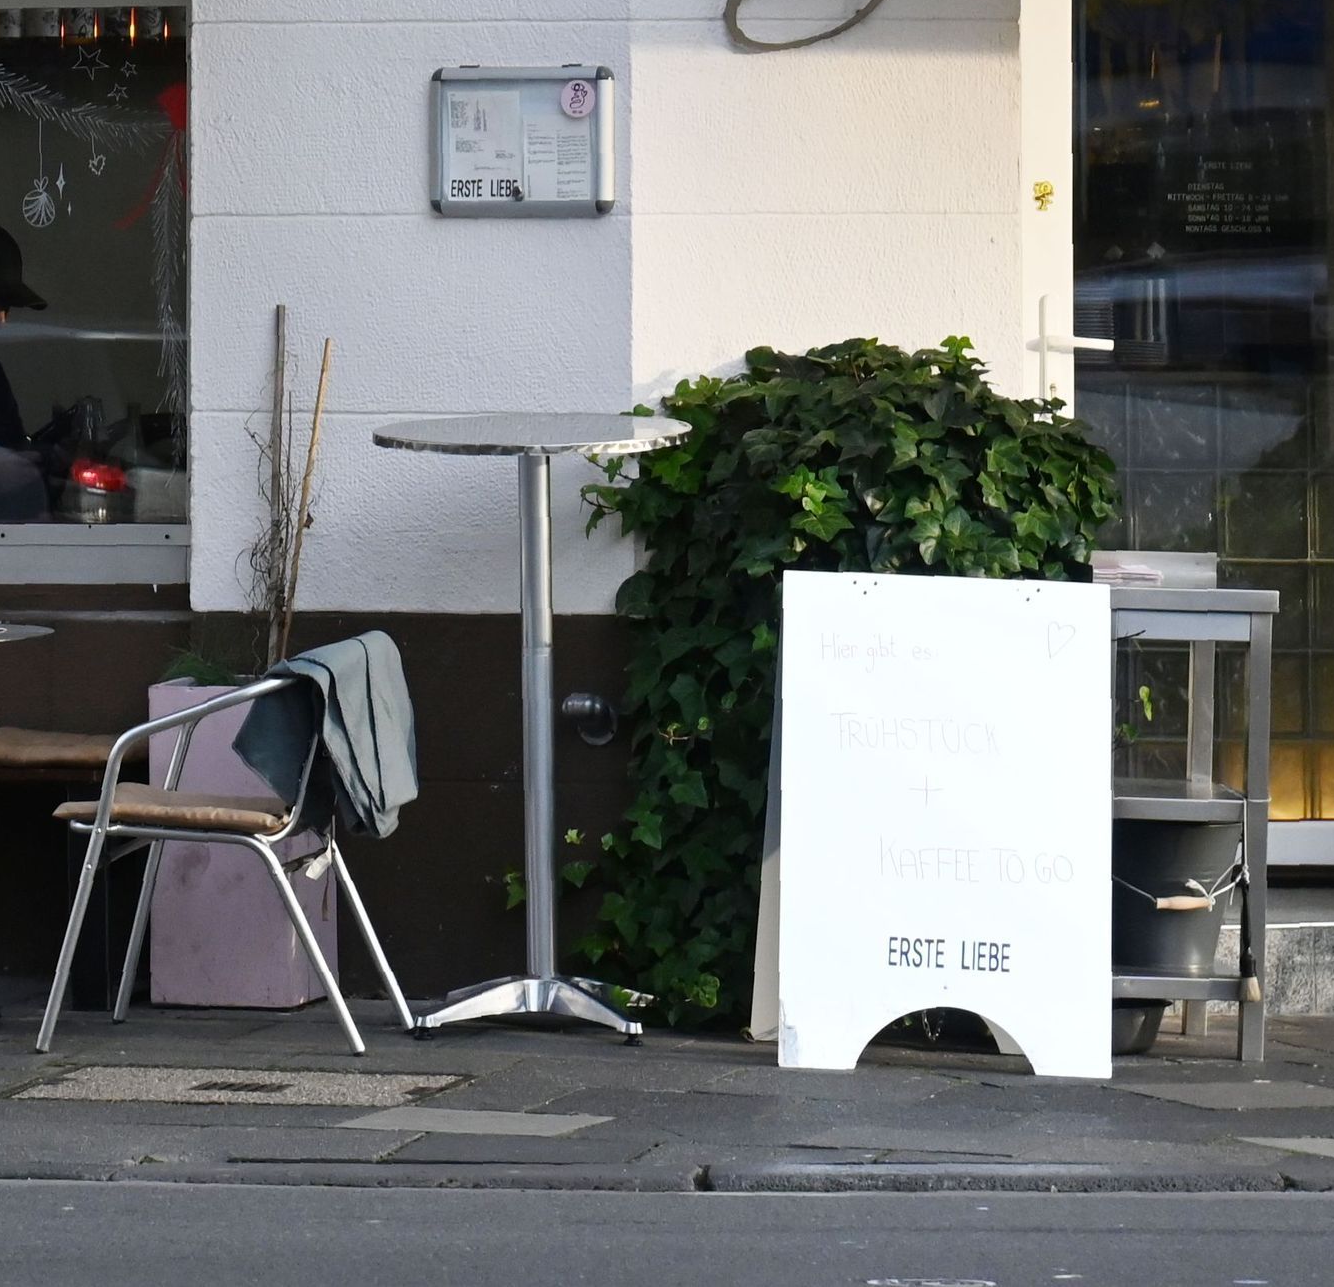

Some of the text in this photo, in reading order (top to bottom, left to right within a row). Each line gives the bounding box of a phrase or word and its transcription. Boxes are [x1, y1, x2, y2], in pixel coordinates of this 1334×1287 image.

[450, 179, 483, 198] ERSTE
[820, 632, 859, 662] Hier
[865, 633, 898, 674] gibt
[879, 833, 1075, 884] KAFFEE TO GO
[887, 936, 1012, 973] ERSTE LIEBE
